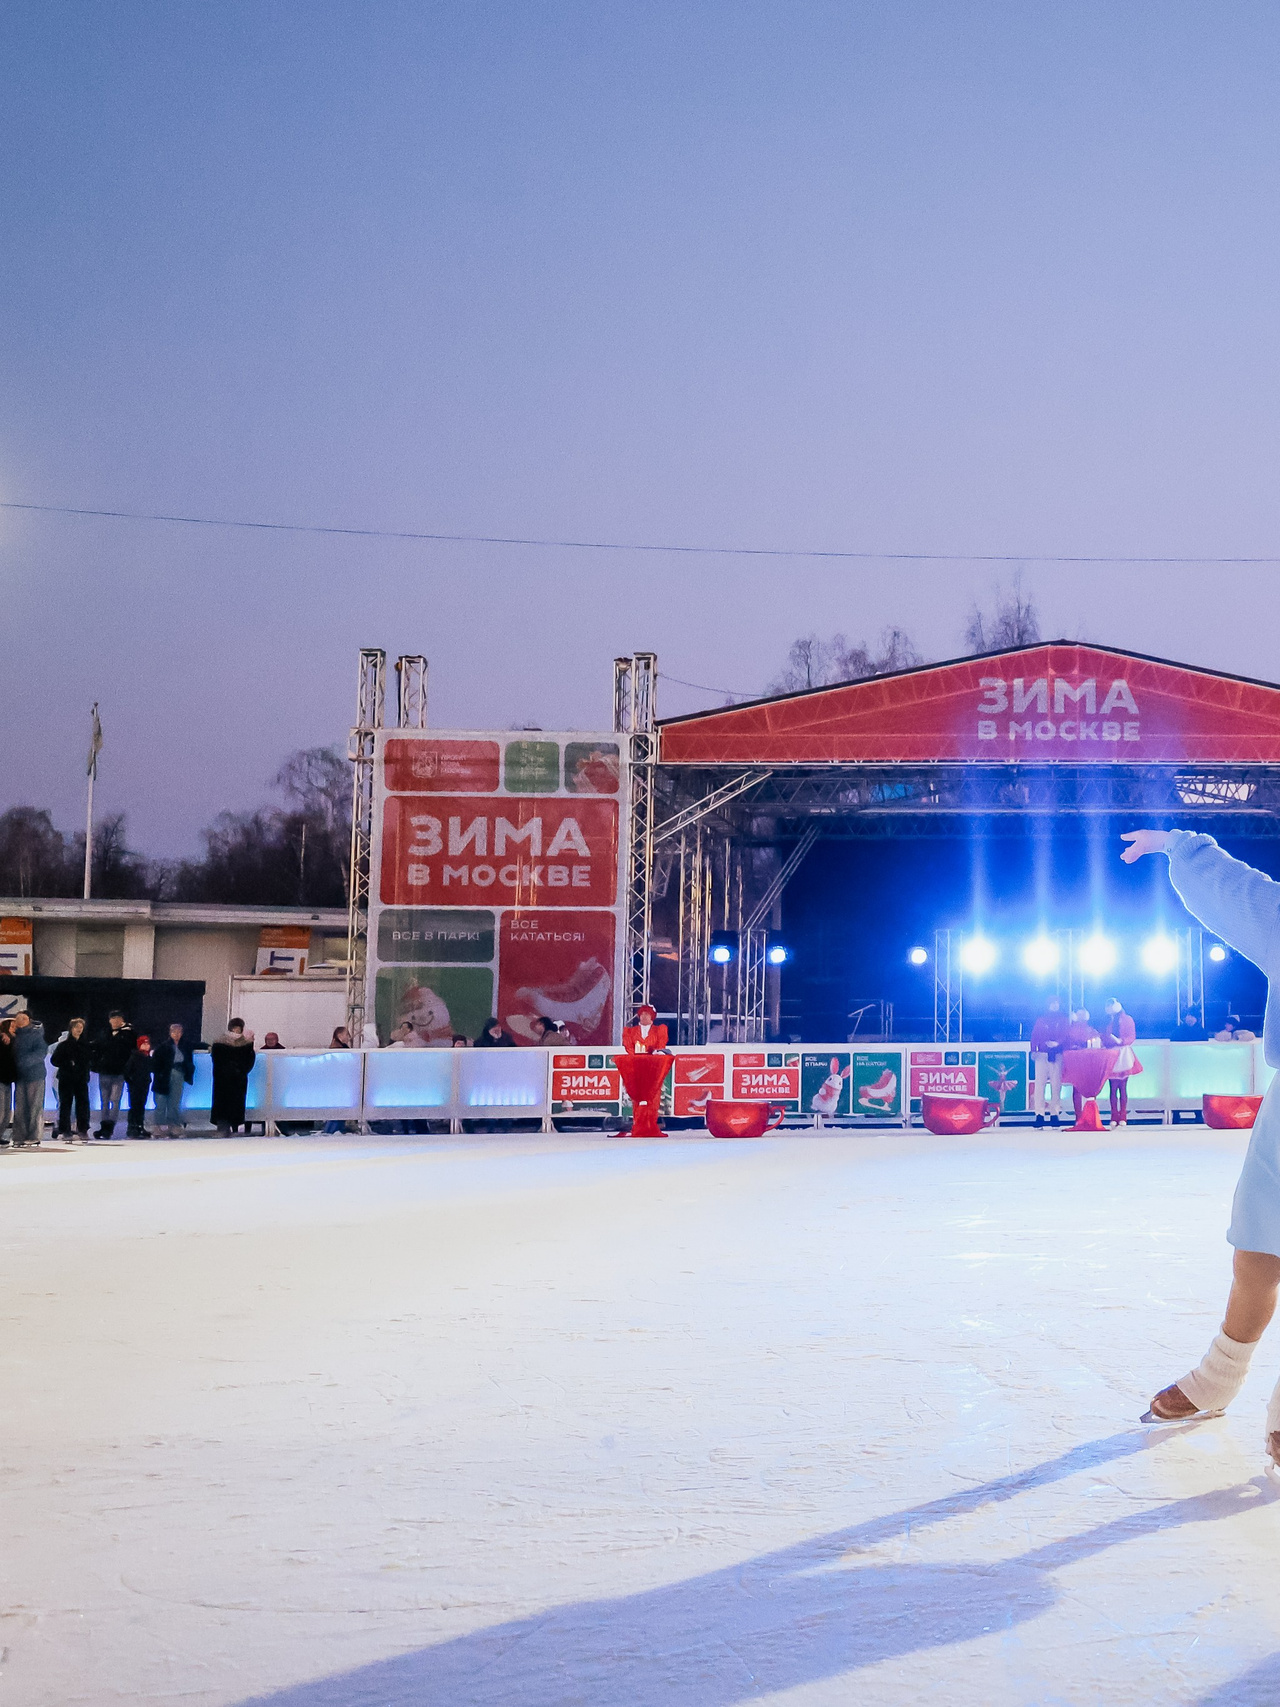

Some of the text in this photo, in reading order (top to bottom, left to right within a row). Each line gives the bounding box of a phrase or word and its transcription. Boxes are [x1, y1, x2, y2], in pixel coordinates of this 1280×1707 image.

[977, 677, 1139, 714] ЗИМА
[977, 720, 1140, 741] В МОСКВЕ
[408, 815, 591, 857] ЗИМА
[408, 864, 591, 887] В МОСКВЕ
[511, 920, 538, 929] ВСЕ
[392, 931, 480, 941] ВСЕ В ПАРК!
[511, 932, 585, 942] КАТАТЬСЯ!
[561, 1075, 611, 1088] ЗИМА
[741, 1074, 790, 1086] ЗИМА
[919, 1072, 967, 1084] ЗИМА
[561, 1088, 611, 1096] В МОСКВЕ
